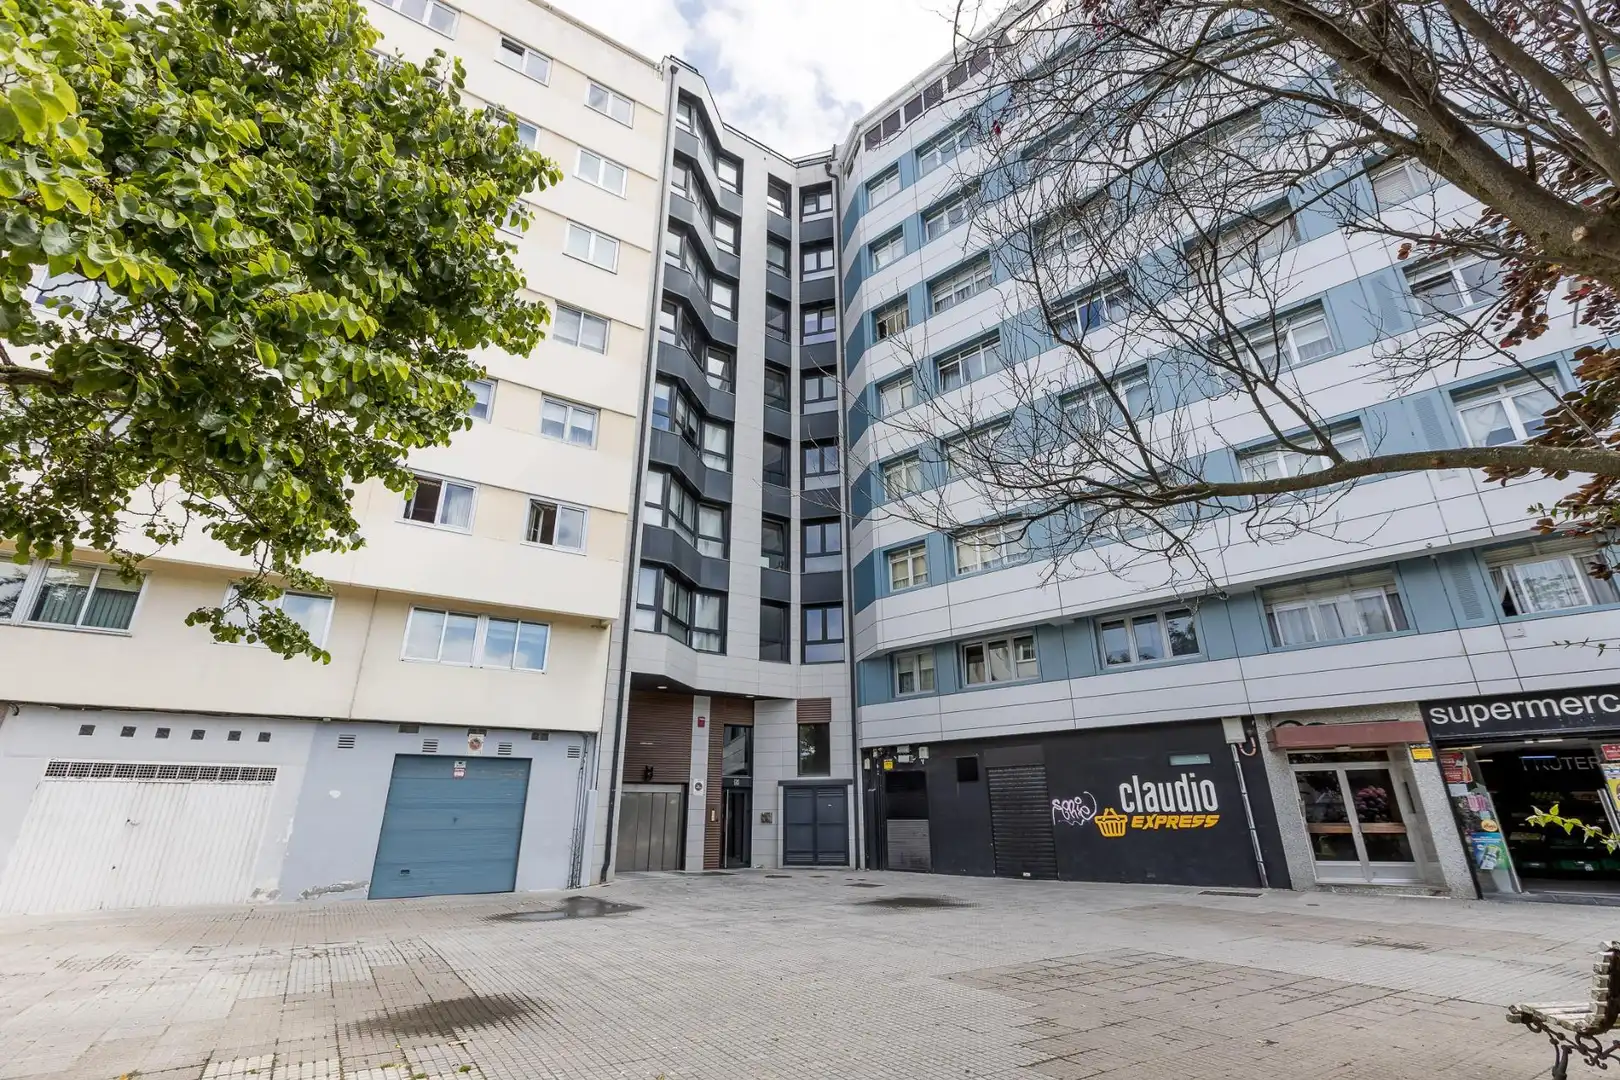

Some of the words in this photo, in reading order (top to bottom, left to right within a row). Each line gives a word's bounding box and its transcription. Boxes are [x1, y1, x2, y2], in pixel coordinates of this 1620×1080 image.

[1429, 693, 1620, 728] supermerc
[1119, 772, 1219, 813] claudio
[1131, 814, 1220, 830] EXPRESS
